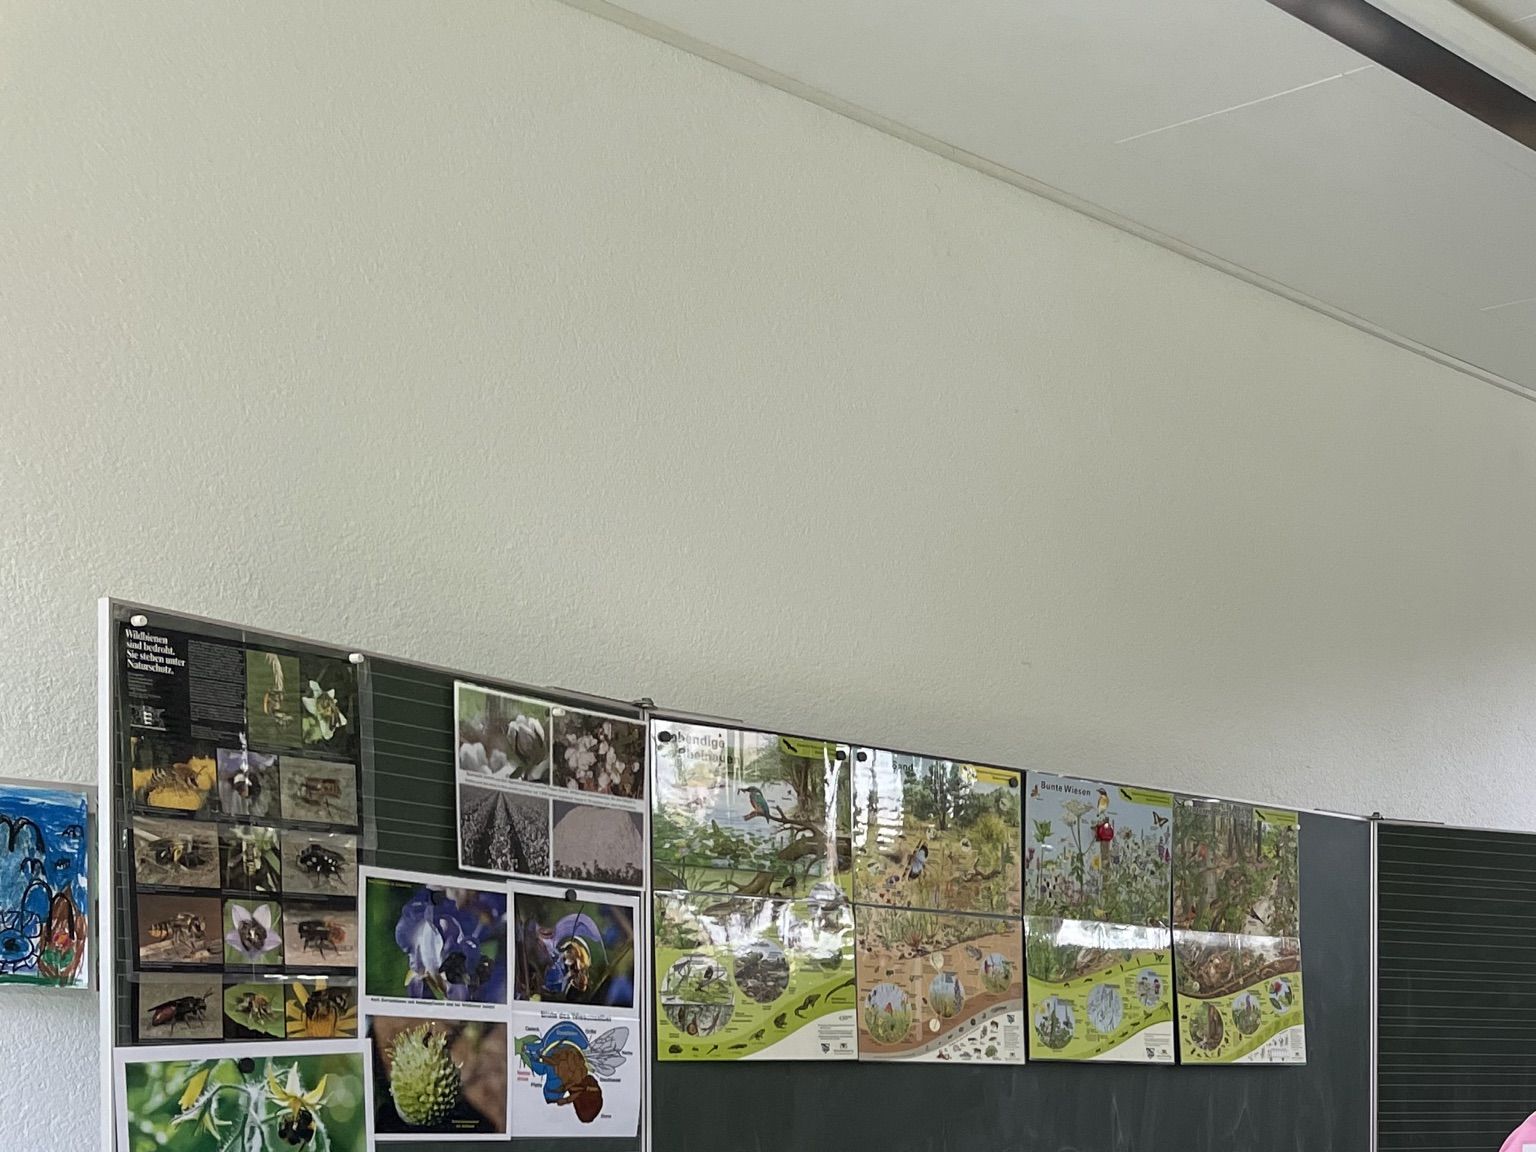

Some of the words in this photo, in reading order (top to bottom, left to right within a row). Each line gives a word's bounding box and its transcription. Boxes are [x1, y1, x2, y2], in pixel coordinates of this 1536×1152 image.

[125, 628, 168, 645] Wildbienen
[126, 640, 142, 651] sind
[143, 641, 175, 656] bedroht.
[126, 649, 139, 660] Sie
[140, 651, 164, 664] stehen
[165, 657, 186, 667] unter
[127, 658, 175, 675] Naturschutz.
[1040, 781, 1063, 793] Bunte
[1064, 784, 1091, 797] Wiesen
